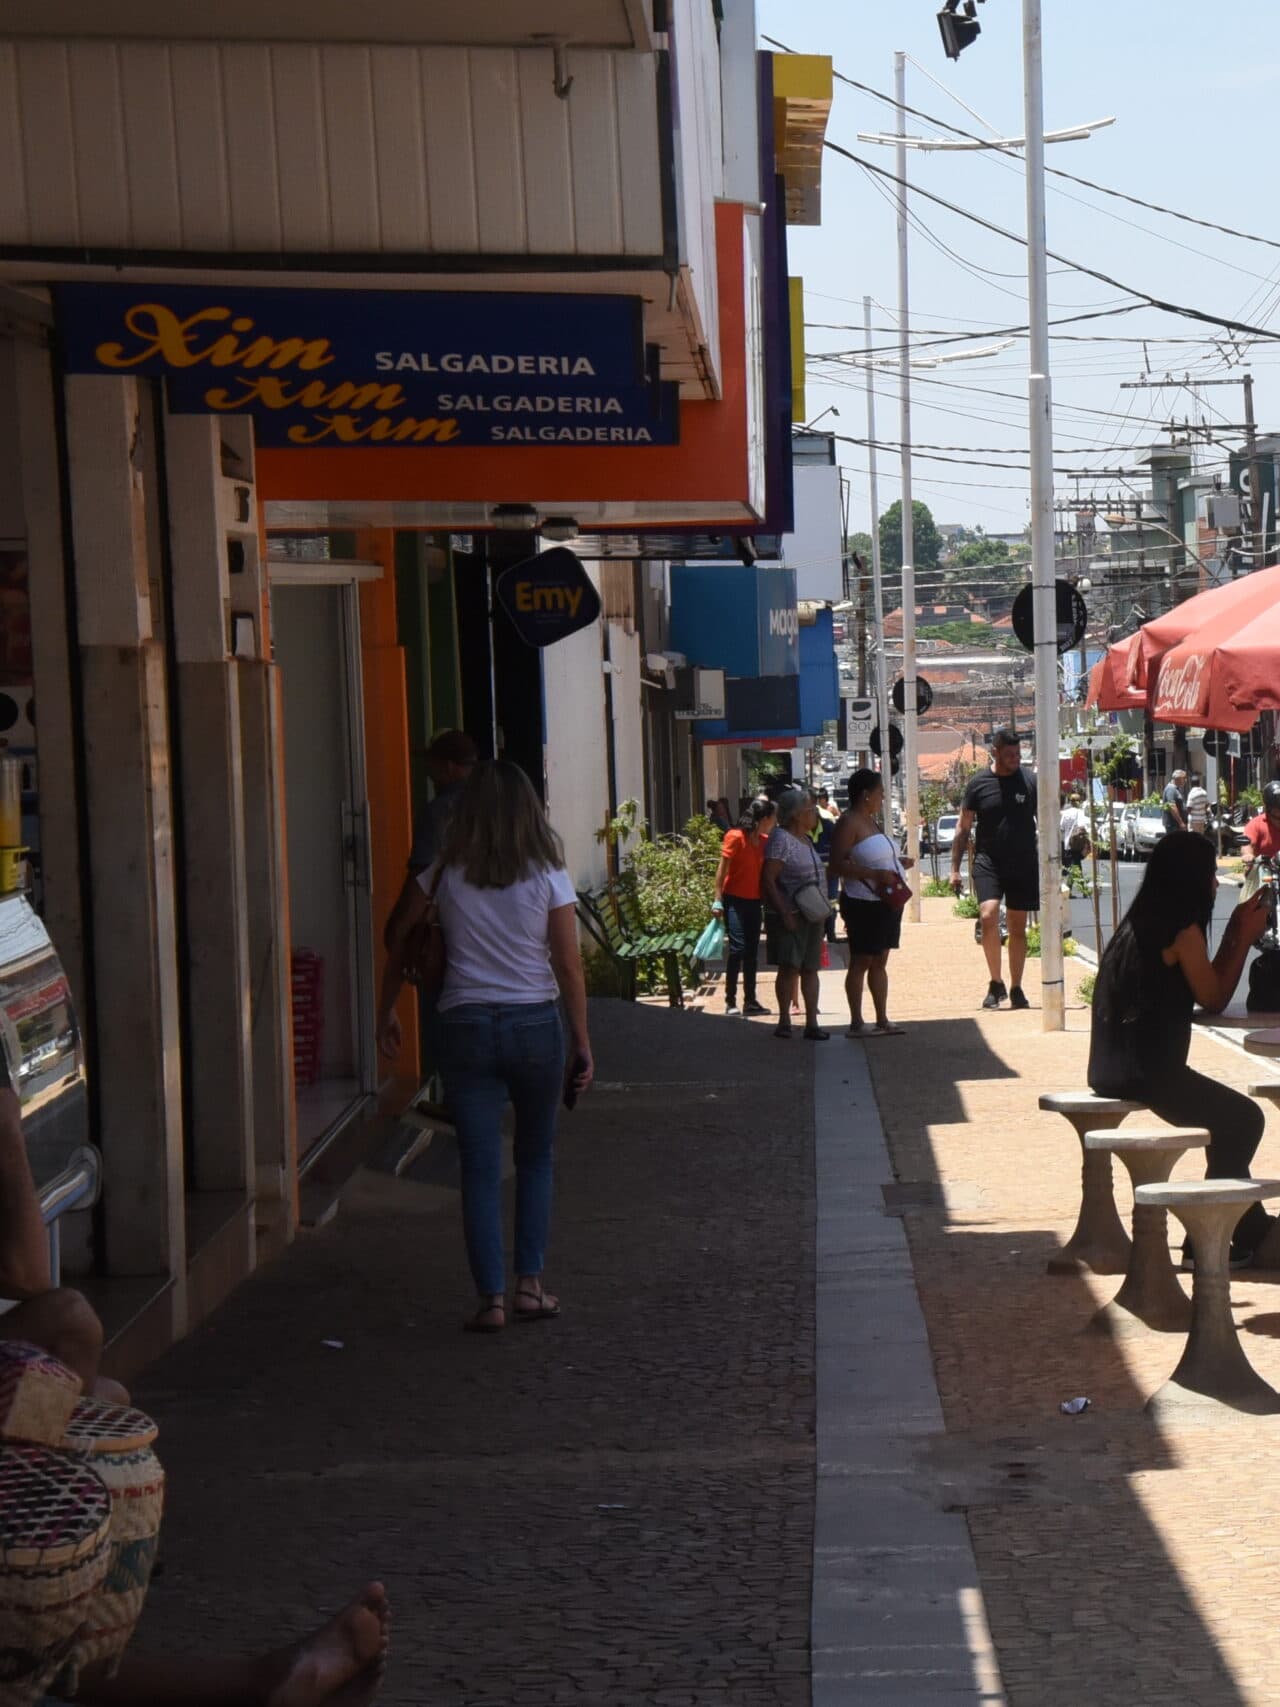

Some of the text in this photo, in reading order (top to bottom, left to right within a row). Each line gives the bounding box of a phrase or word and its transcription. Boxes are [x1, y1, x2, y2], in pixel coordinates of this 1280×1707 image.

[95, 303, 596, 376] Xim SALGADERIA
[437, 394, 624, 414] SALGADERIA
[491, 426, 653, 441] SALGADERIA
[515, 581, 583, 619] Emy
